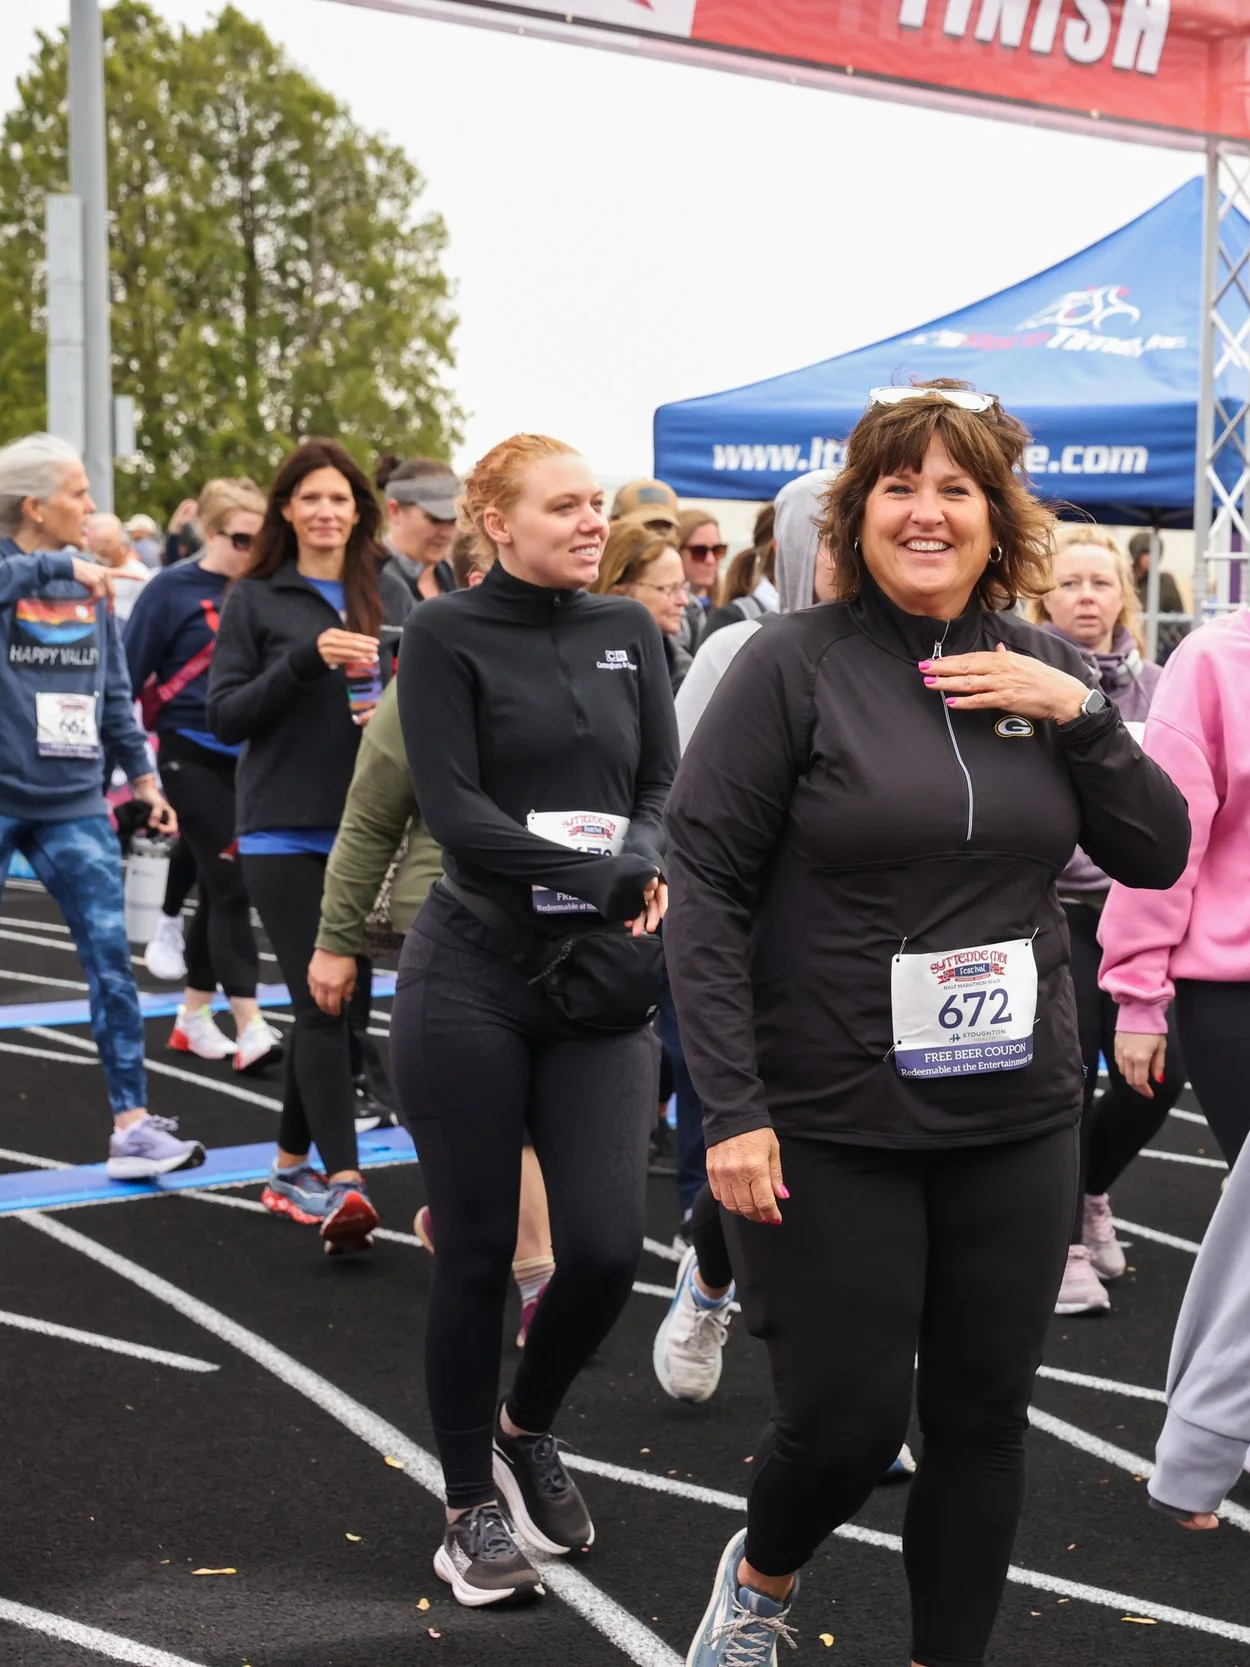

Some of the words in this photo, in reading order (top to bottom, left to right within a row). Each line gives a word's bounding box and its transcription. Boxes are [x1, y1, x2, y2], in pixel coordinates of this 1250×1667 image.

[899, 0, 1171, 76] ISH
[10, 644, 59, 665] HAPPY
[536, 903, 579, 912] Redeemable
[957, 980, 987, 989] MARATHON
[938, 988, 1013, 1029] 672
[962, 1029, 1006, 1038] STOUGHTON
[924, 1051, 953, 1063] FREE
[954, 1048, 984, 1060] BEER
[984, 1042, 1027, 1057] COUPON
[901, 1065, 952, 1077] Redeemable
[952, 1065, 961, 1073] at
[962, 1063, 977, 1072] the
[978, 1056, 1027, 1071] Entertainment
